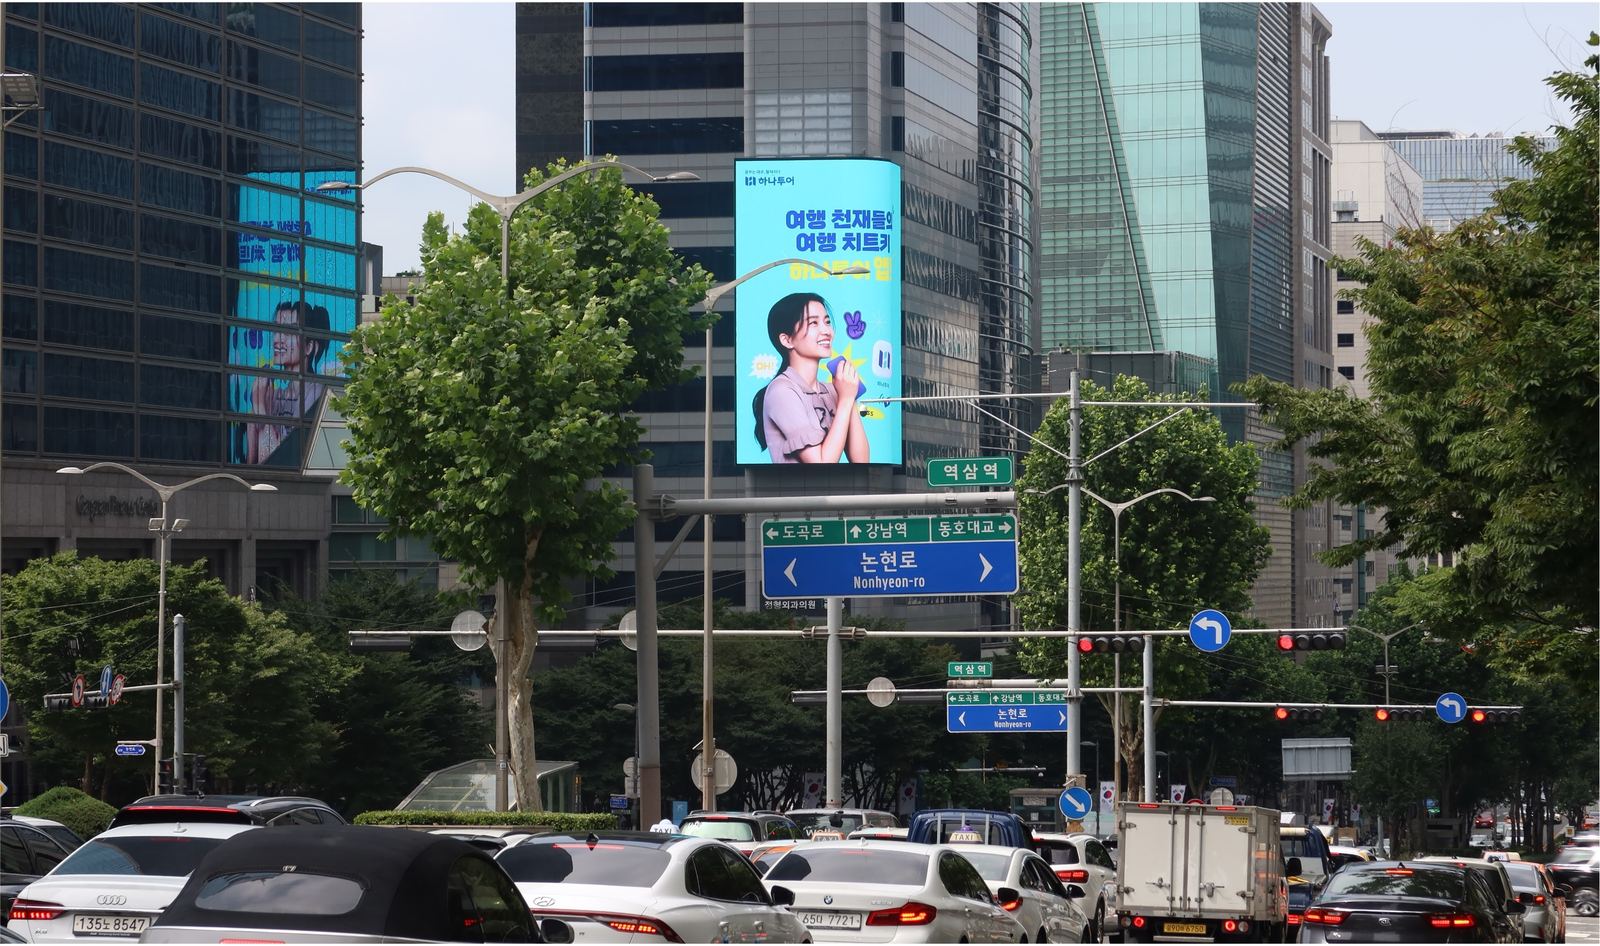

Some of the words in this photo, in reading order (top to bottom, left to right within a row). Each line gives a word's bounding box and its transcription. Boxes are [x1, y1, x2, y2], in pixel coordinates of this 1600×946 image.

[758, 176, 795, 186] 하나투어
[785, 209, 826, 230] 여행
[831, 209, 893, 231] 천재들의
[796, 232, 837, 253] 여행
[842, 232, 891, 253] 치트키
[873, 256, 892, 282] 앱
[943, 462, 998, 481] 역삼역
[782, 525, 825, 540] 도곡로
[865, 522, 908, 539] 강남역
[938, 520, 995, 538] 동호대교
[860, 550, 918, 573] 논현로
[853, 575, 925, 591] Nonhyeon-ro
[954, 665, 986, 675] 역삼역
[958, 694, 980, 703] 도곡로
[1001, 694, 1023, 703] 강남역
[997, 708, 1028, 720] 논현로
[994, 721, 1031, 729] Nonhyeon-ro
[954, 833, 974, 841] TAXI
[80, 917, 111, 930] 135노
[113, 918, 146, 931] 8547
[828, 915, 854, 926] 7721
